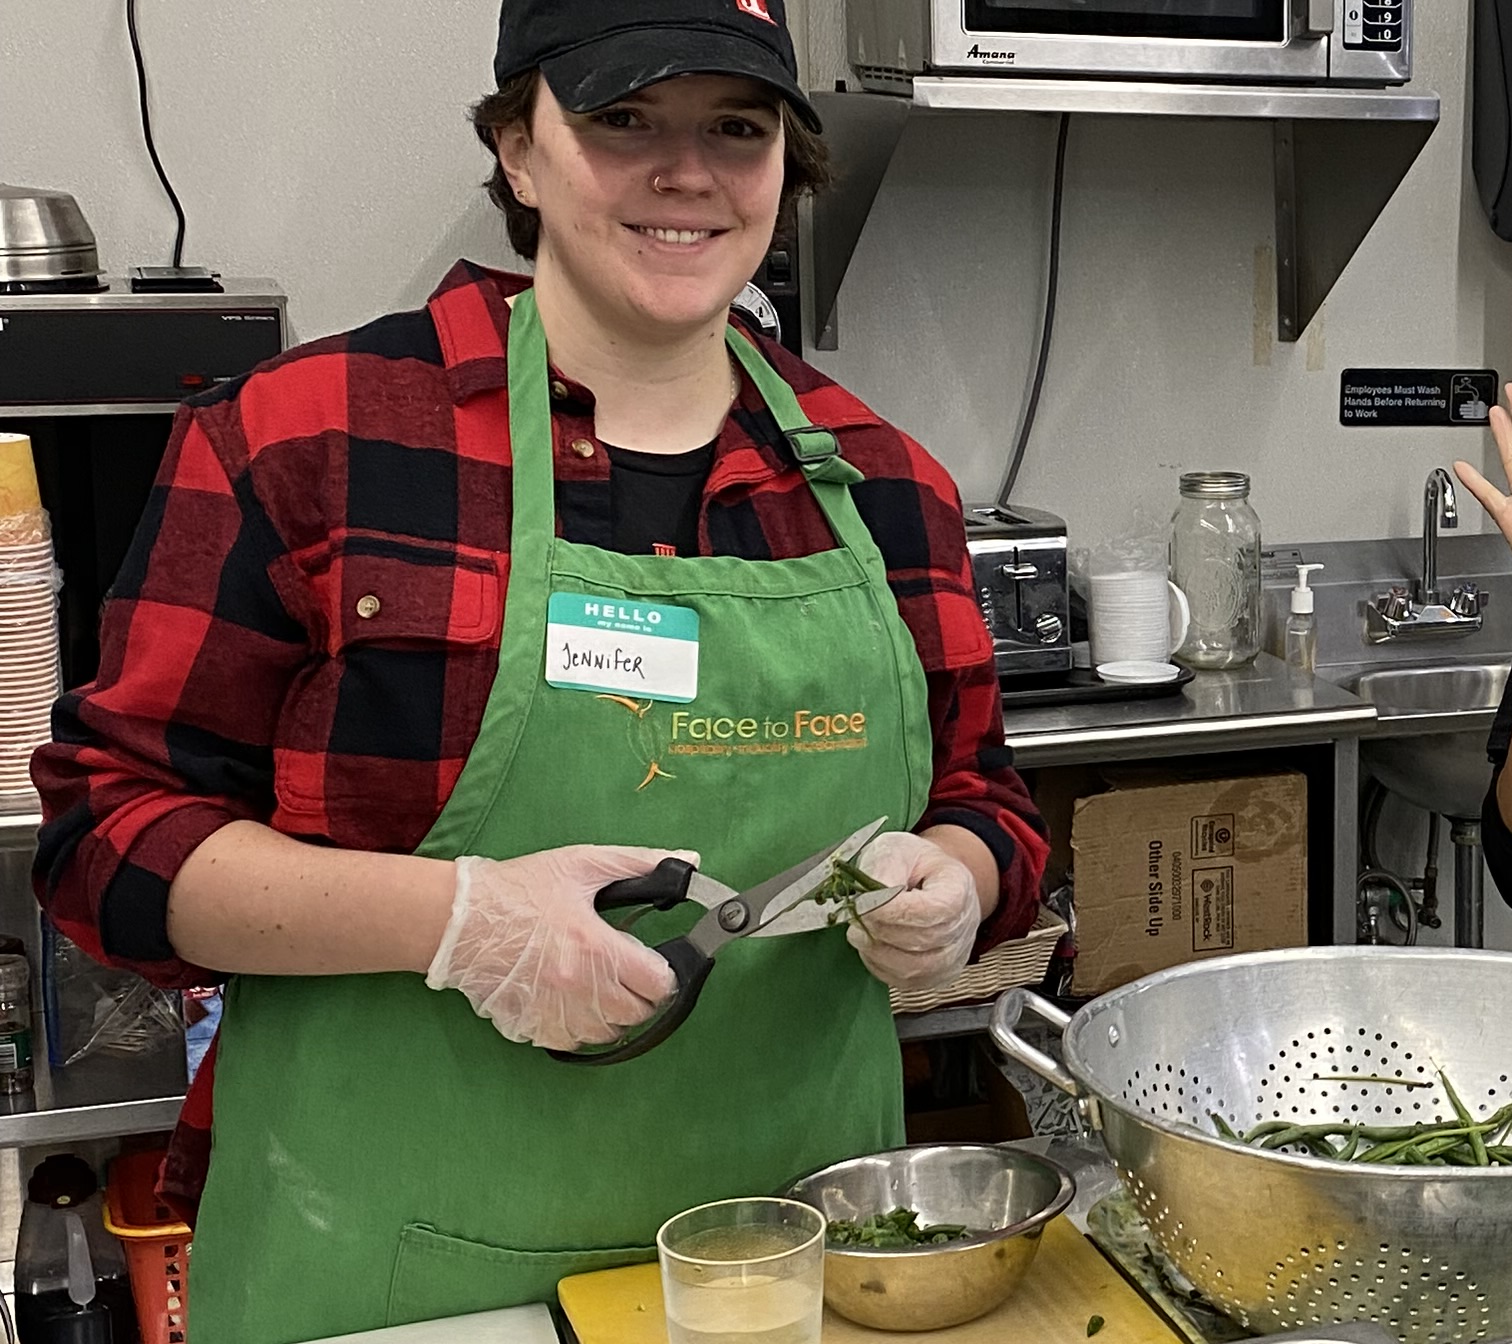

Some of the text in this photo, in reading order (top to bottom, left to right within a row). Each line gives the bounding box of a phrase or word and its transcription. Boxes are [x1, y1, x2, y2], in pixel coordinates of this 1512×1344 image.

[1384, 12, 1392, 23] 9
[1383, 29, 1391, 40] 0
[966, 44, 1016, 59] Amana
[1345, 385, 1441, 396] Employees Must Wash
[1344, 397, 1446, 409] Hands Before Returning
[1344, 409, 1378, 418] to Work
[585, 602, 661, 624] HELLO
[614, 622, 641, 631] name
[672, 709, 866, 741] Face to Face
[1145, 840, 1163, 937] Other Side Up
